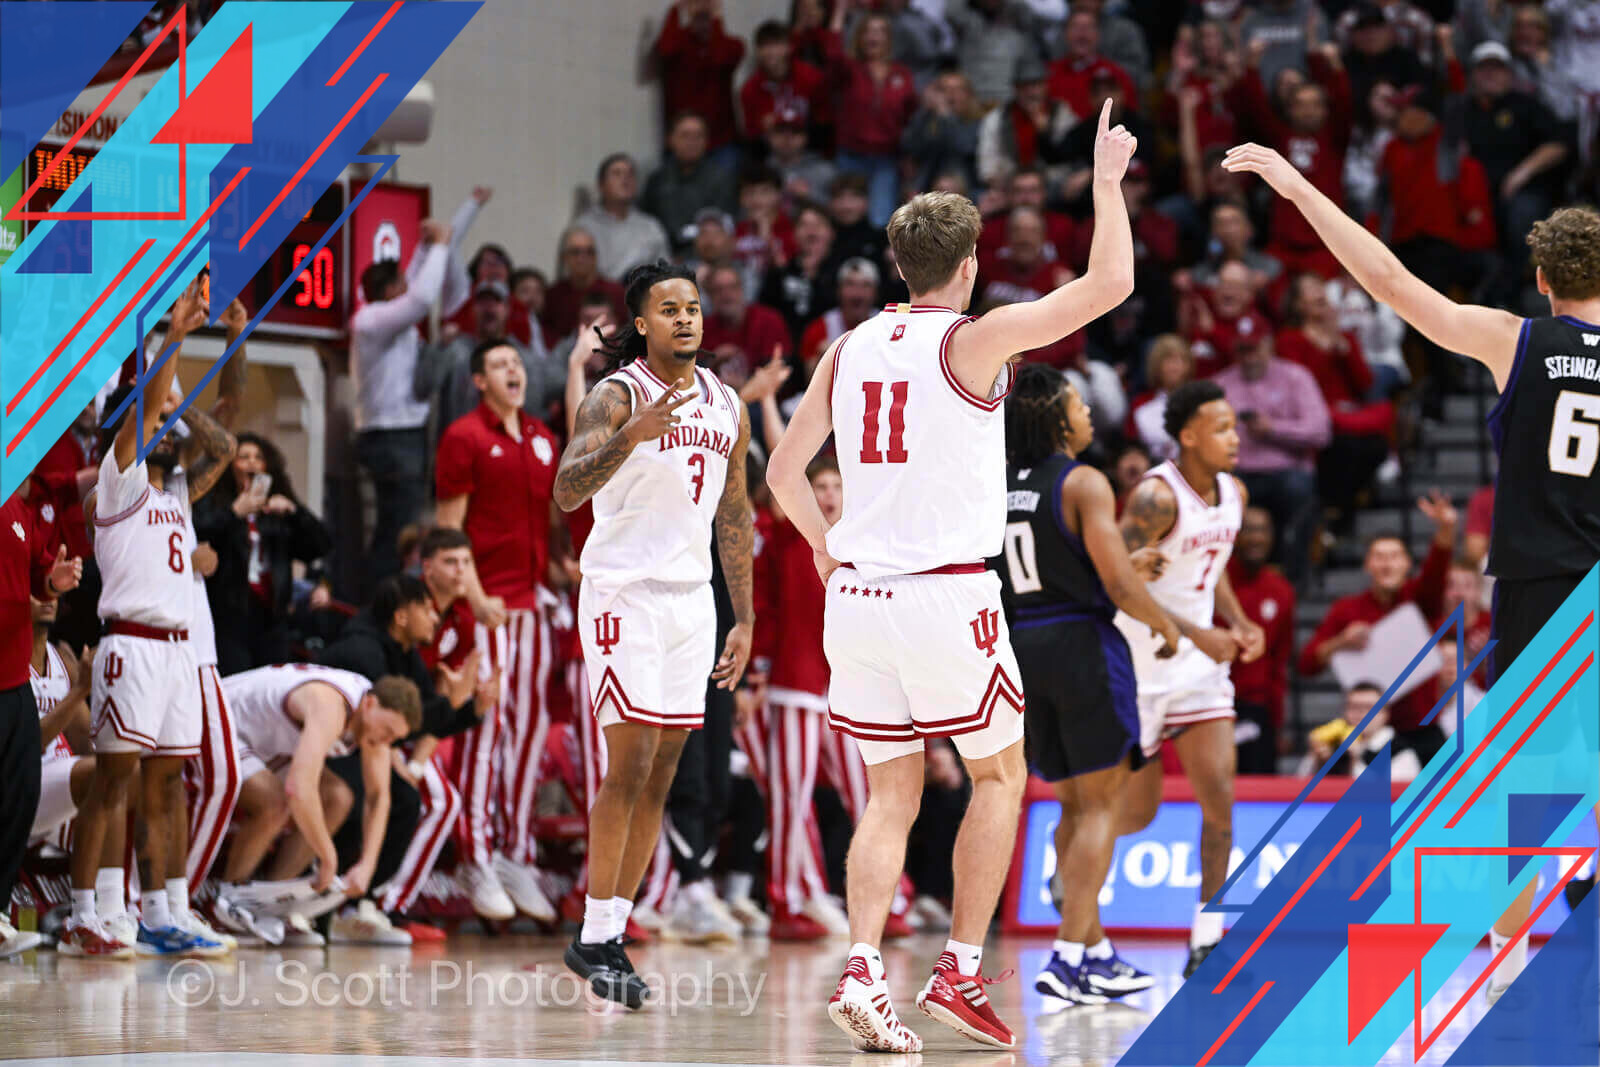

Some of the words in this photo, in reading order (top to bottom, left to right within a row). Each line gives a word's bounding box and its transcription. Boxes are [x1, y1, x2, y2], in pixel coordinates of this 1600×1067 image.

[292, 244, 334, 309] 50
[658, 425, 731, 459] INDIANA
[859, 380, 909, 464] 11
[1548, 390, 1600, 478] 6
[688, 453, 705, 505] 3
[168, 531, 184, 573] 6
[1005, 521, 1042, 594] 0
[1195, 549, 1219, 591] 7
